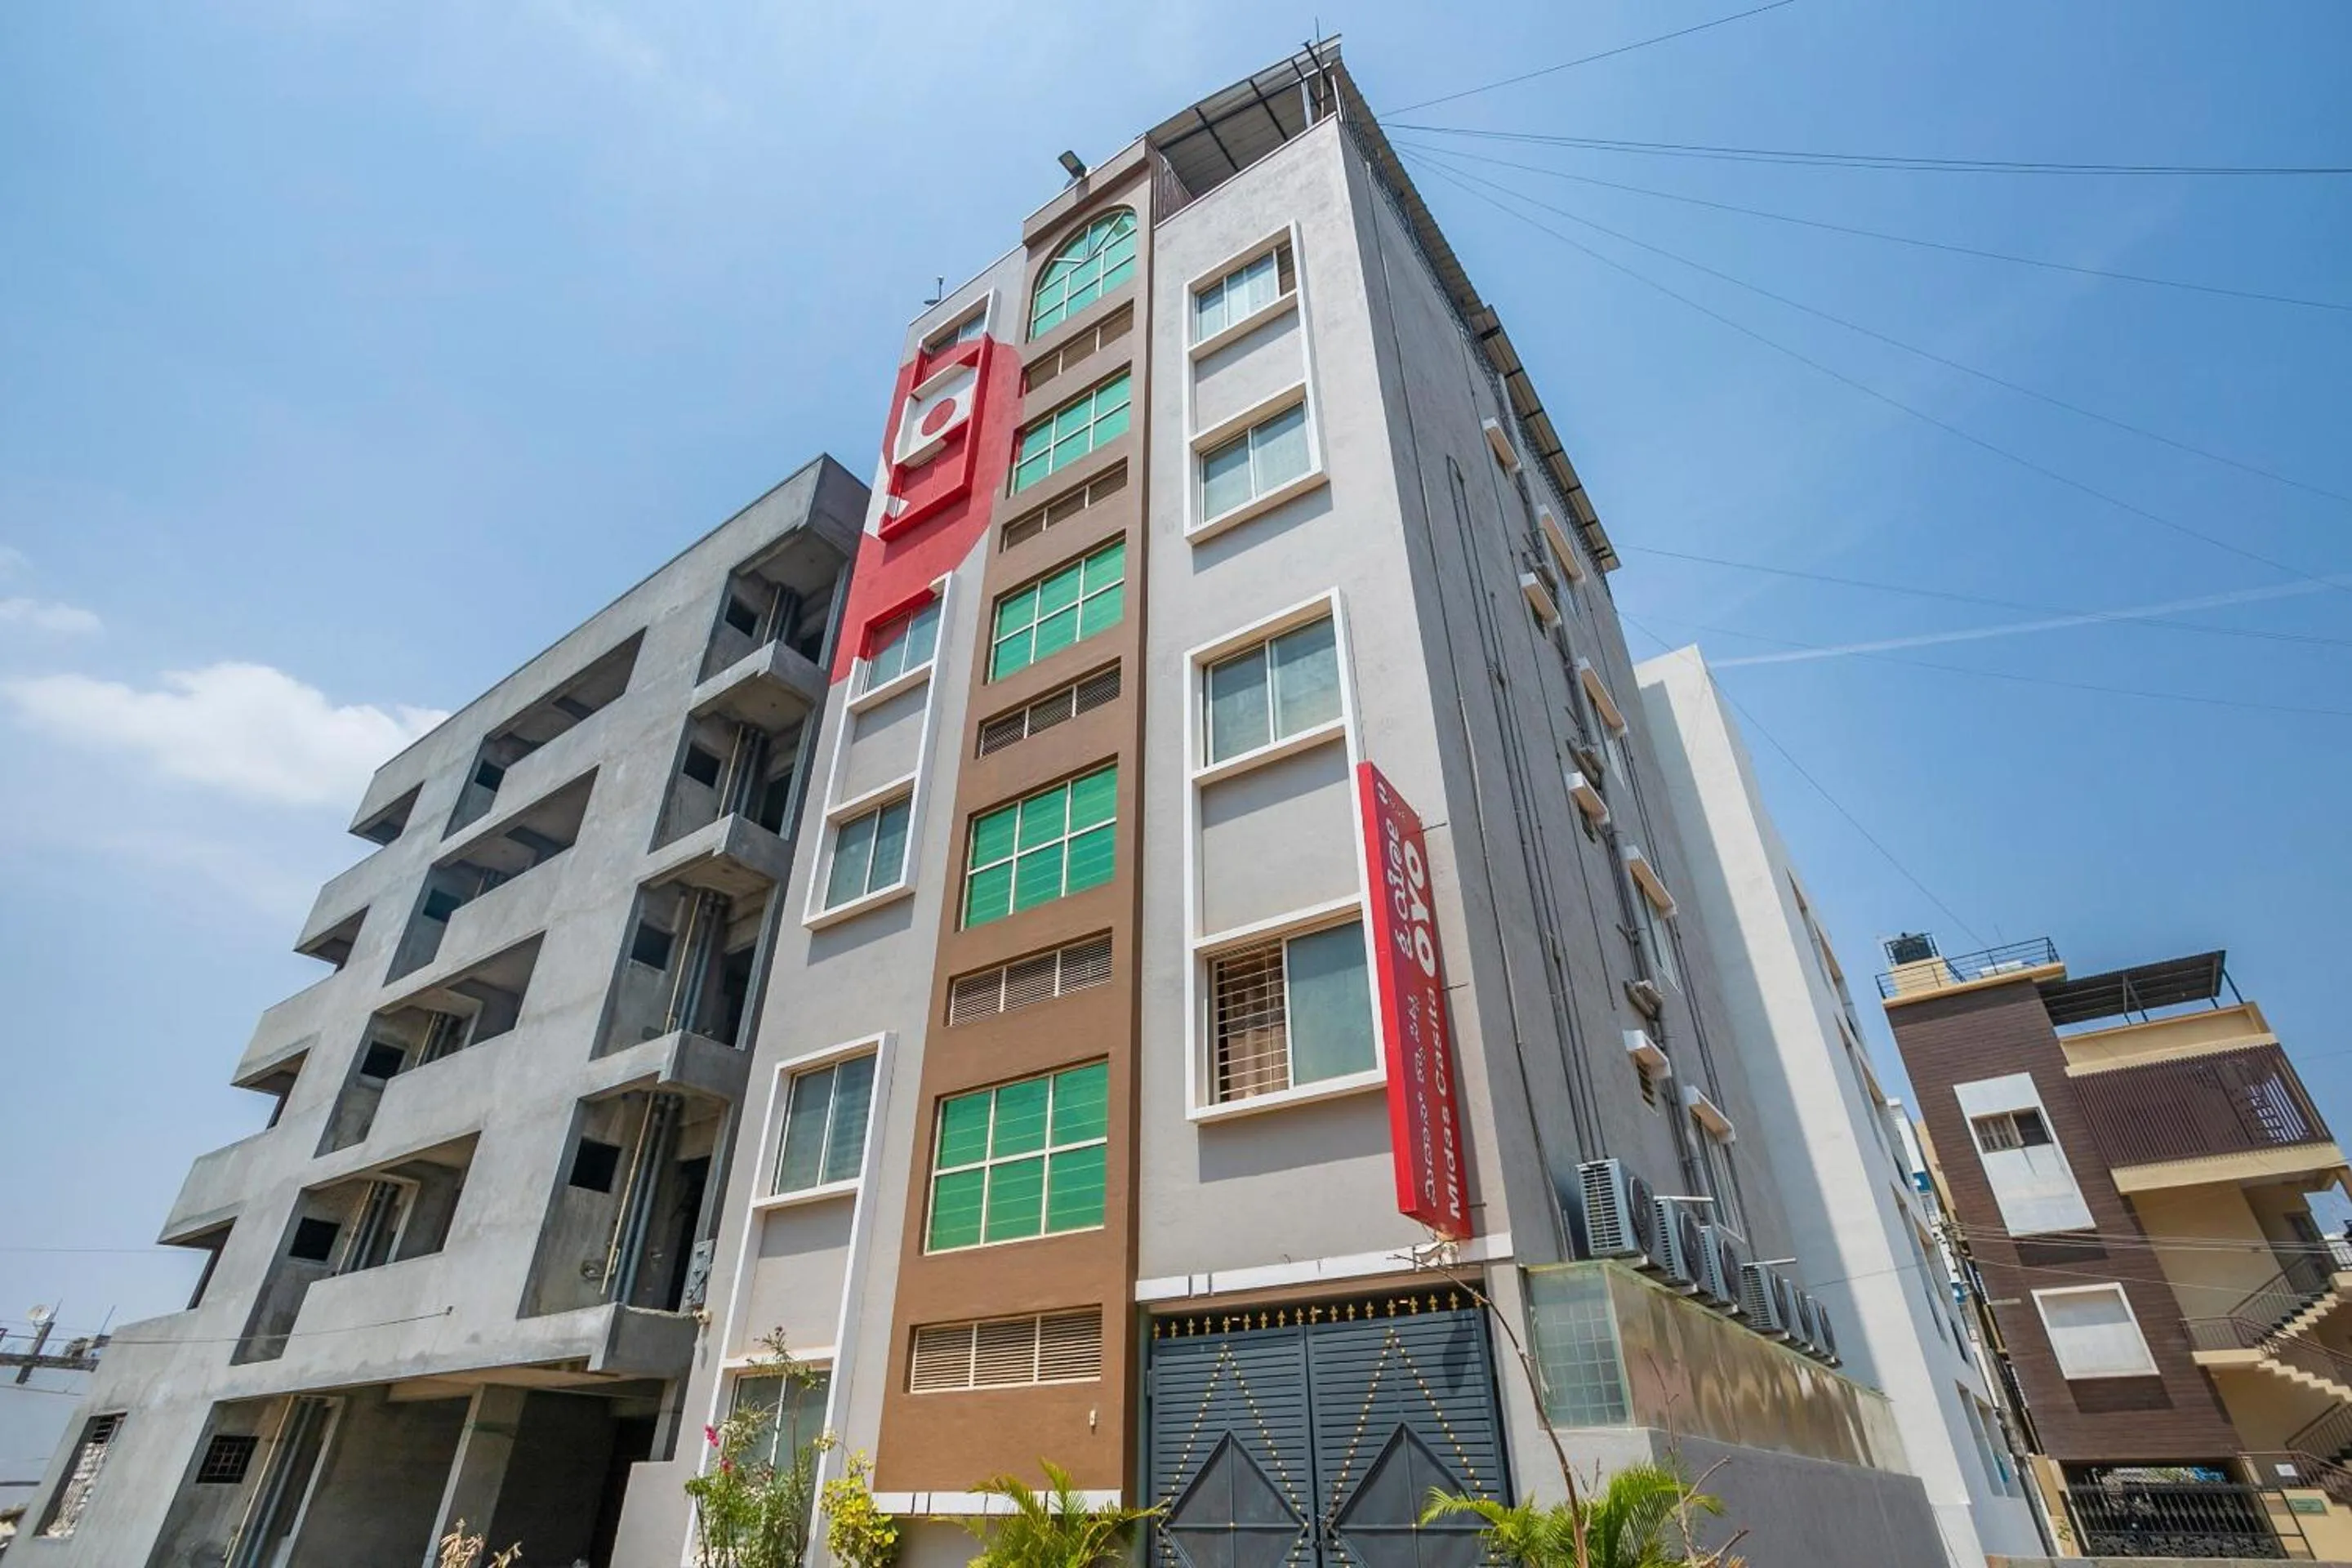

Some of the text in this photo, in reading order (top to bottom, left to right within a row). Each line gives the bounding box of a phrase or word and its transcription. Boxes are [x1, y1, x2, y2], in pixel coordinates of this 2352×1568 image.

[1404, 840, 1435, 977] OYO
[1427, 987, 1460, 1219] Midas Casita
